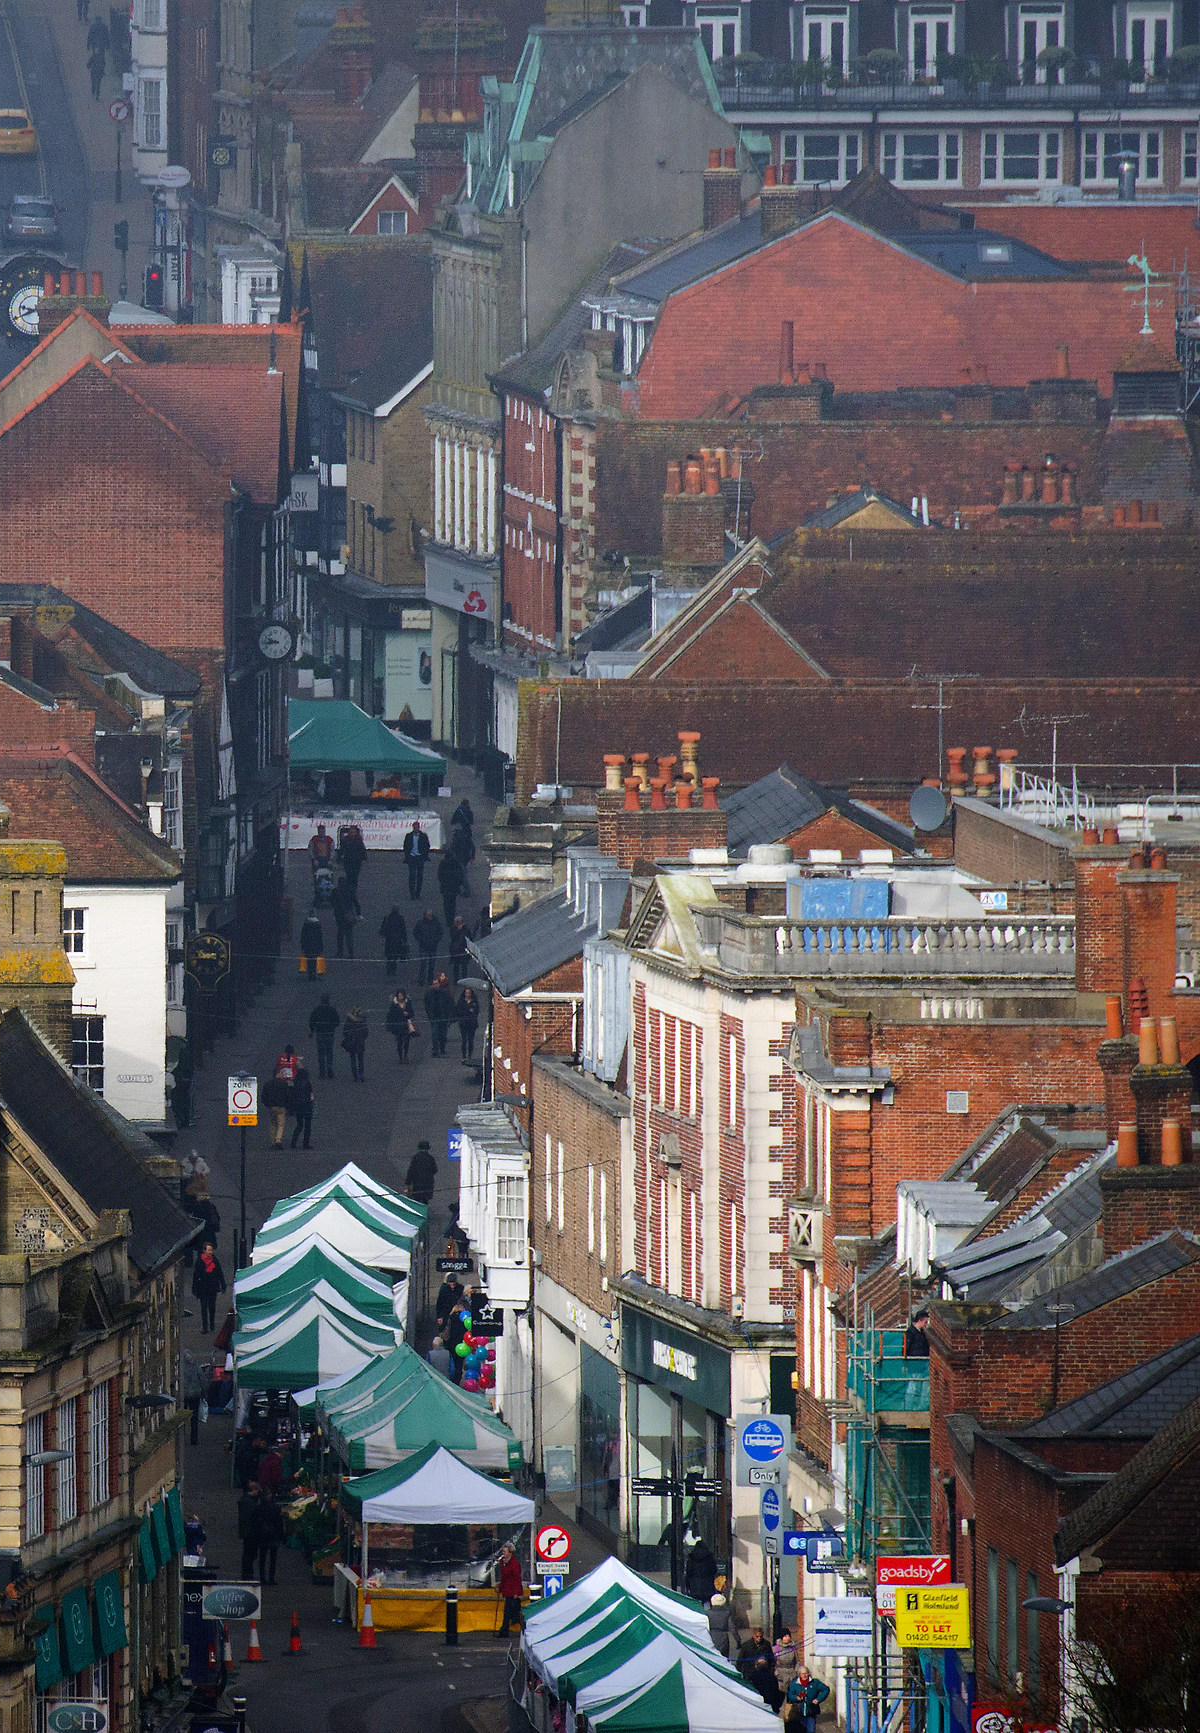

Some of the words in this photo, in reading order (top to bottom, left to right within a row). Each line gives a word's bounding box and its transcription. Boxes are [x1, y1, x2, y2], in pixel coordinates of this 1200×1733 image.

[754, 1471, 774, 1481] Only
[880, 1565, 935, 1582] goadsby
[215, 1591, 245, 1604] Coffee
[220, 1604, 245, 1616] Shop
[916, 1625, 928, 1633] TO
[933, 1625, 951, 1633] LET
[55, 1711, 97, 1731] C&H
